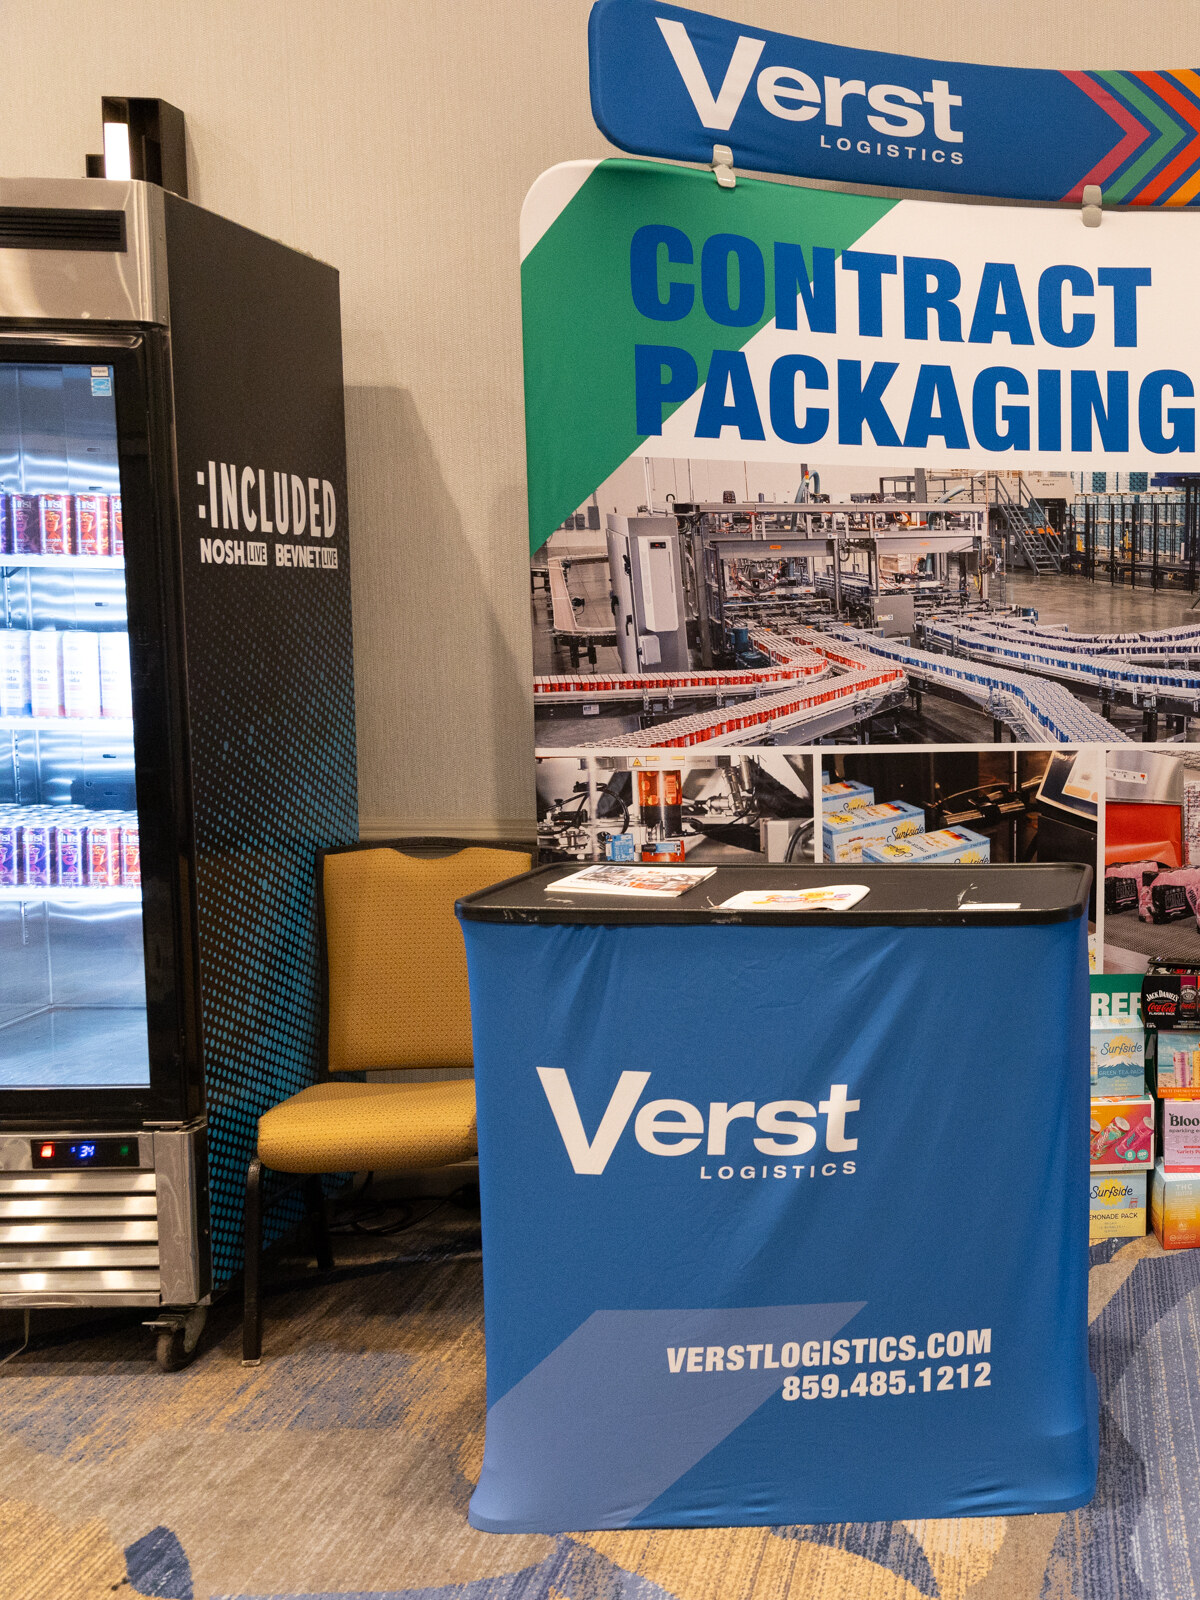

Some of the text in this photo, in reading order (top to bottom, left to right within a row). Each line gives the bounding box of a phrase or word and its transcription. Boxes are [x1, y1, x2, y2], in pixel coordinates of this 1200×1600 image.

[655, 16, 964, 144] Verst
[820, 135, 964, 165] LOGISTICS
[629, 224, 1152, 348] CONTRACT
[634, 344, 1196, 454] PACKAGING
[200, 537, 337, 569] NOSH LIVE BEVNET LIVE
[1100, 1041, 1143, 1056] Surfside
[536, 1066, 860, 1175] Verst
[79, 1145, 96, 1157] 34
[700, 1160, 857, 1181] LOGISTICS
[1090, 1186, 1133, 1200] Surfside
[667, 1328, 992, 1374] VERSTLOGISTICS.COM
[782, 1362, 992, 1402] 859.485.1212
